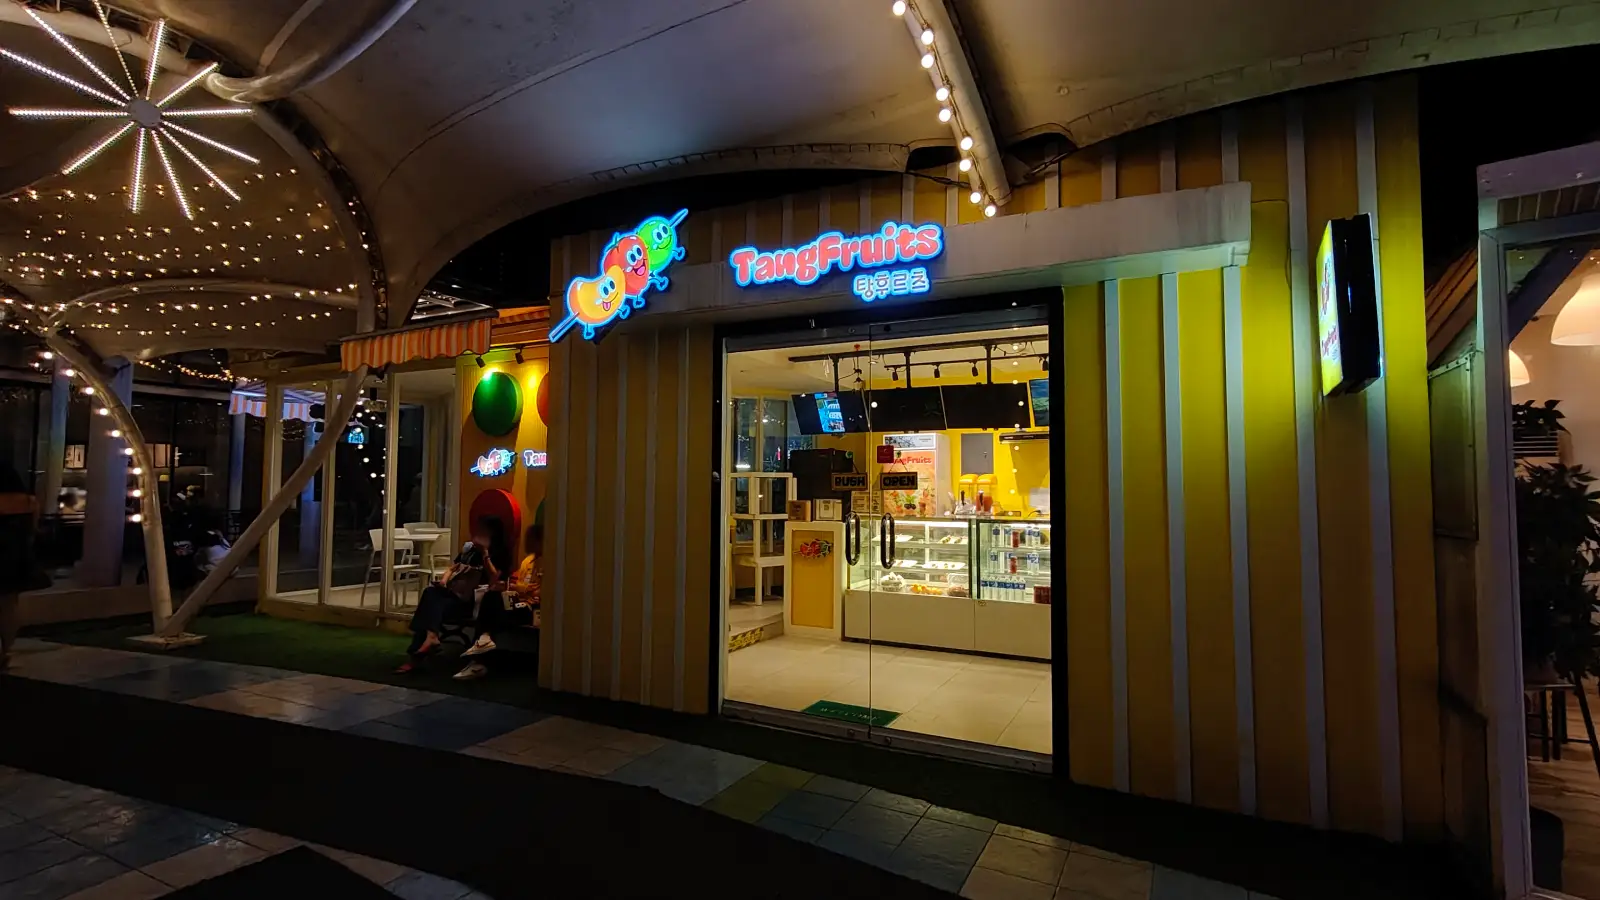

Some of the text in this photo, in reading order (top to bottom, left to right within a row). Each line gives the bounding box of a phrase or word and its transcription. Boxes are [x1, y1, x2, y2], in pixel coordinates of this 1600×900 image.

[731, 223, 941, 284] TangFruits
[855, 270, 928, 299] 탕후르츠
[834, 476, 866, 487] PUSH
[883, 475, 915, 487] OPEN
